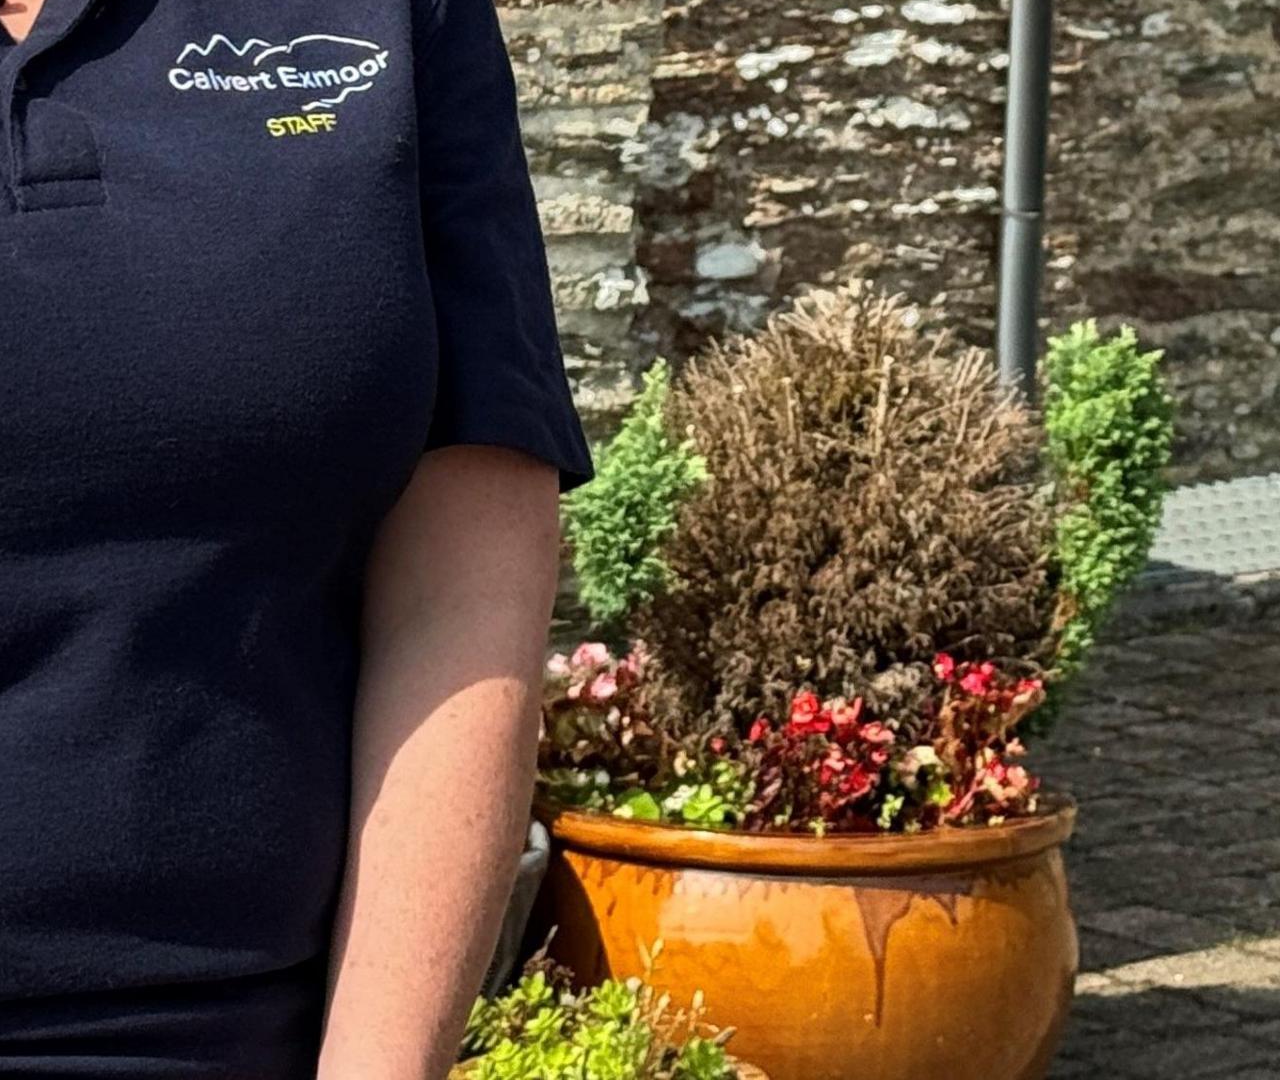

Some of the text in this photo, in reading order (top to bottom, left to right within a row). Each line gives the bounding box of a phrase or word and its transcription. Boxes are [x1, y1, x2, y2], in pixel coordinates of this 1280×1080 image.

[168, 50, 389, 92] Calvert Exmoor
[266, 113, 337, 137] STAFF
